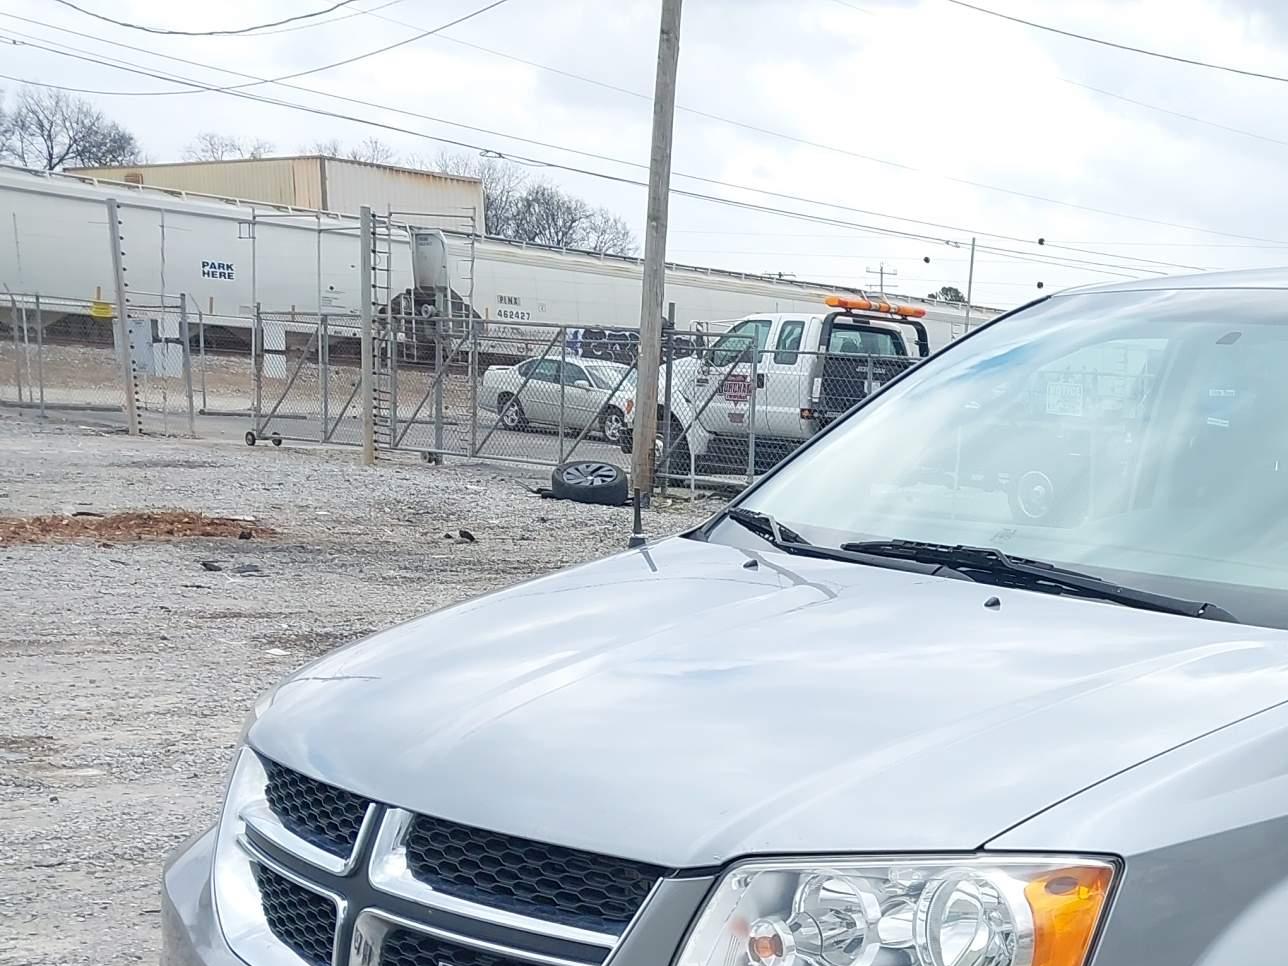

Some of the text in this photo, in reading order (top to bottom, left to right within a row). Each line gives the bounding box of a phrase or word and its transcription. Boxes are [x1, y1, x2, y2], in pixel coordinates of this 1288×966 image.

[201, 261, 234, 271] PARK
[202, 270, 235, 279] HERE
[497, 309, 531, 320] 462427
